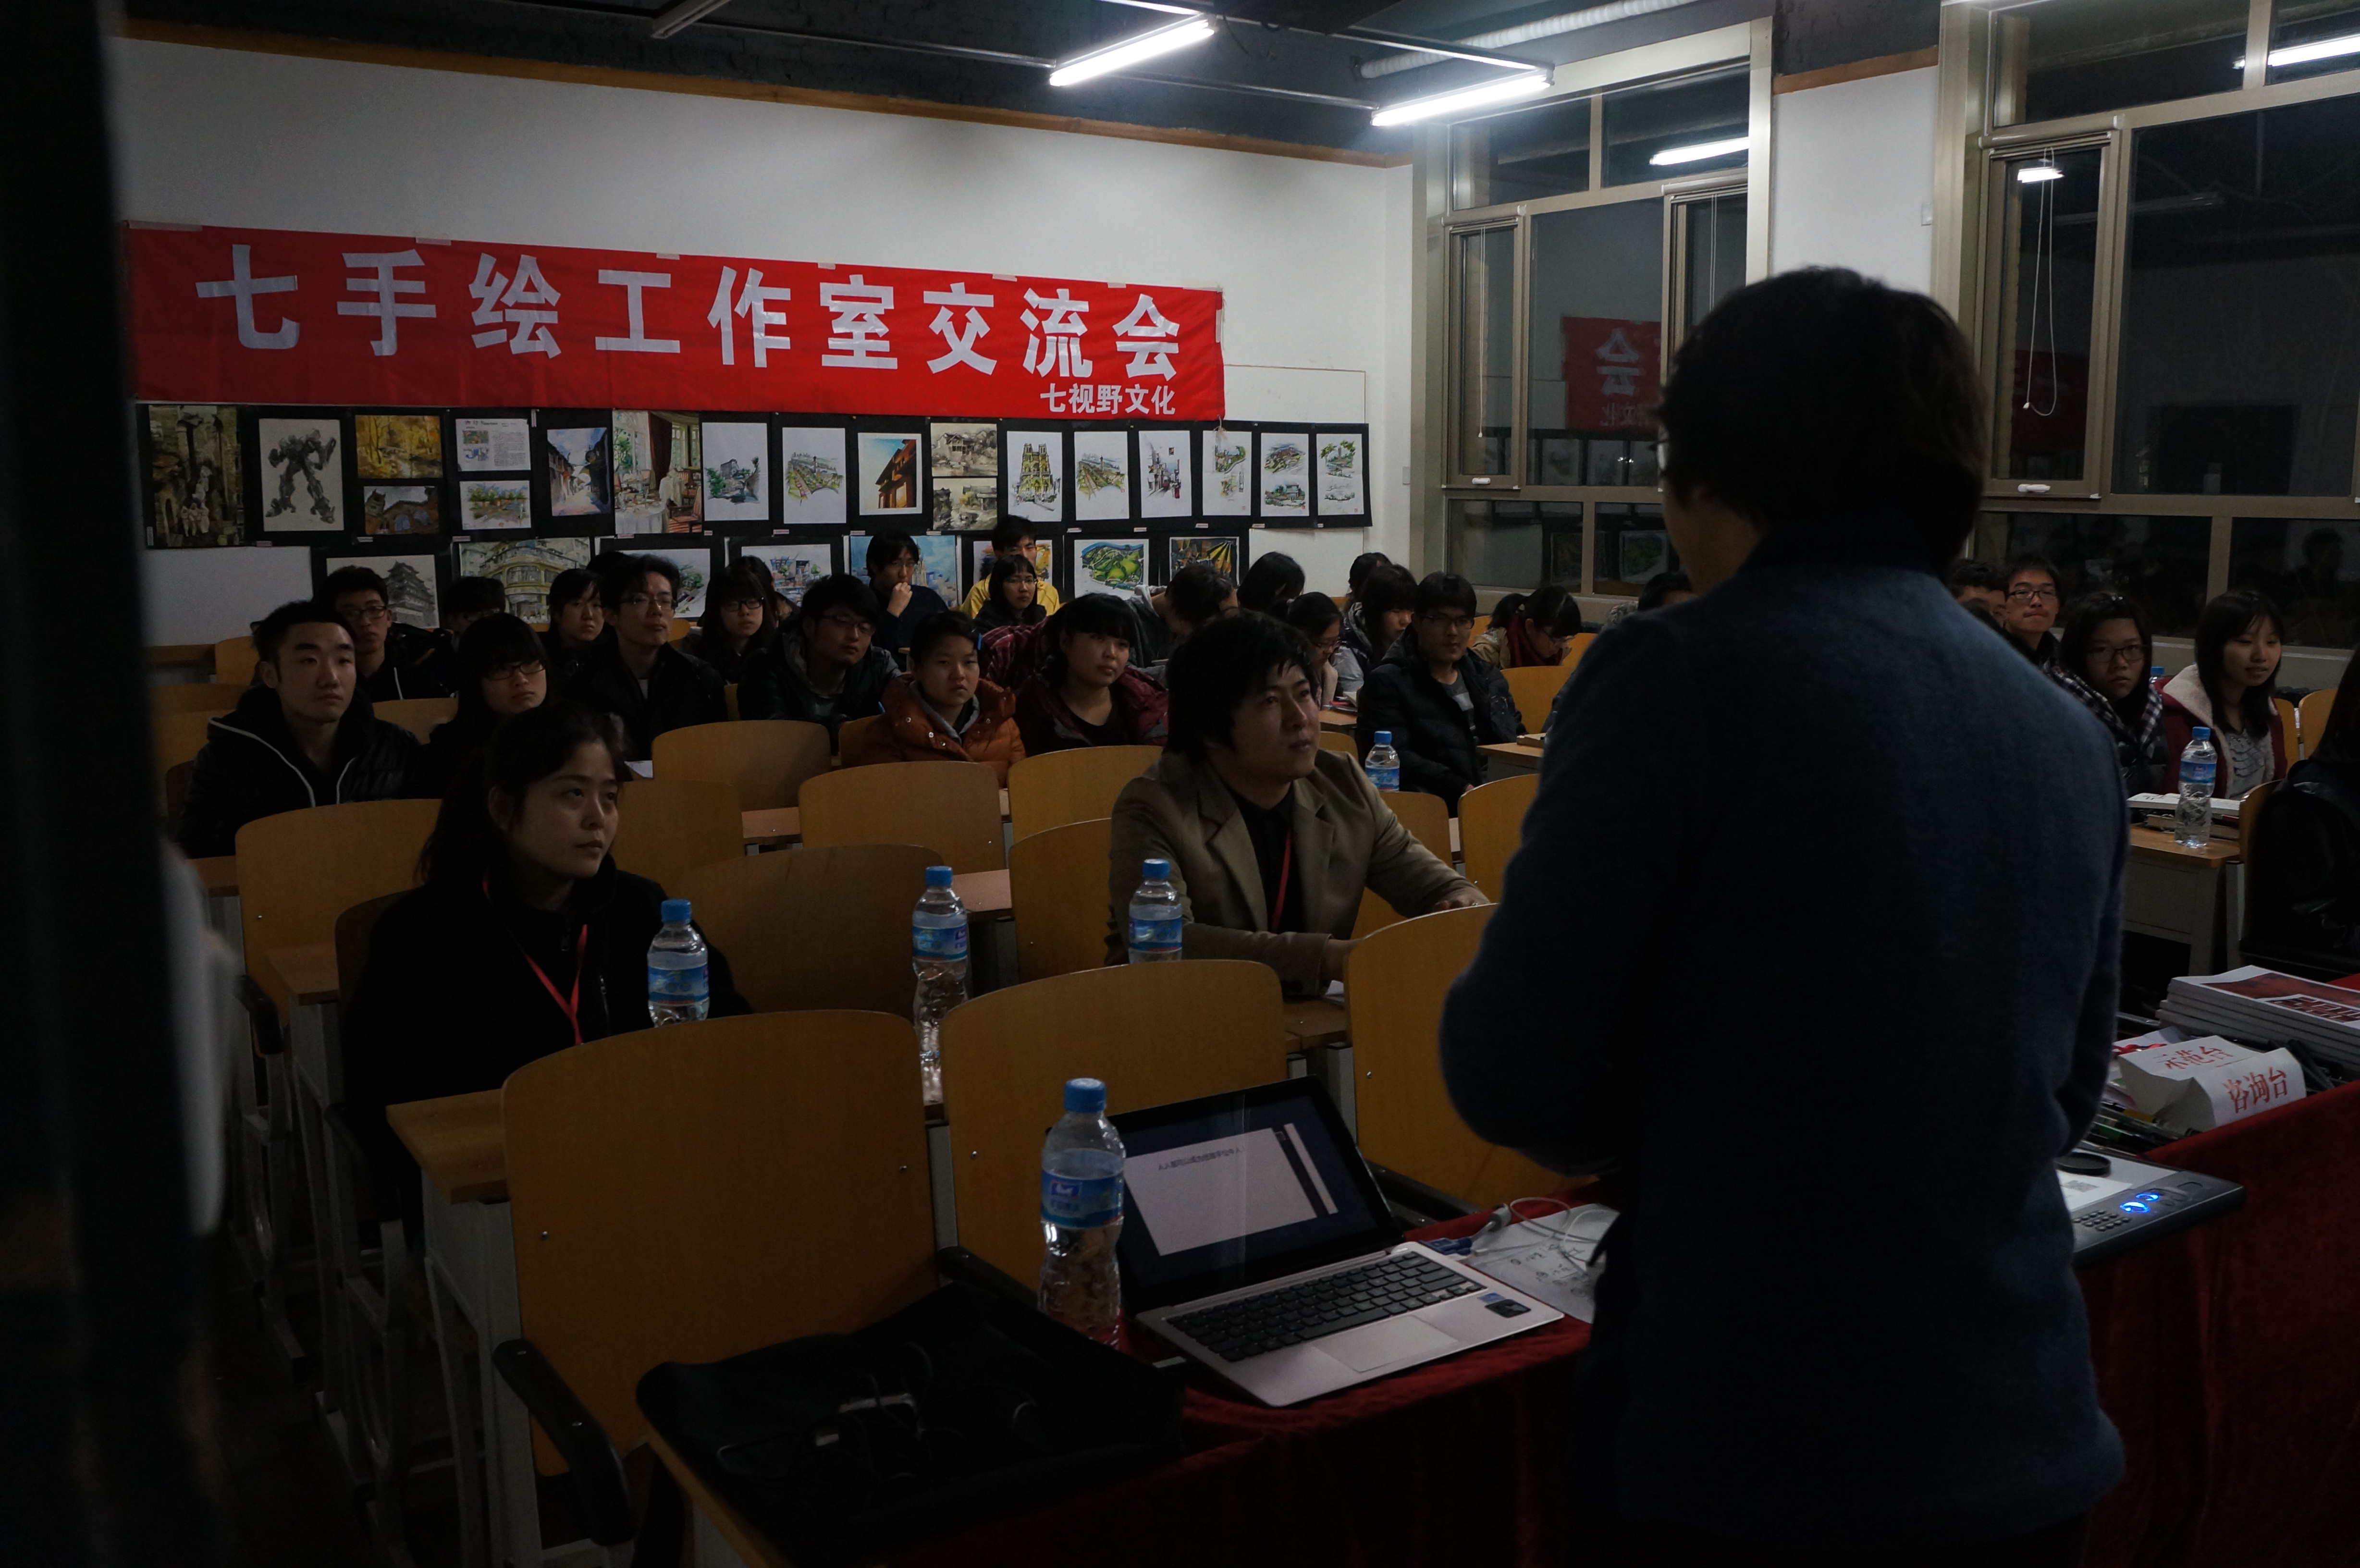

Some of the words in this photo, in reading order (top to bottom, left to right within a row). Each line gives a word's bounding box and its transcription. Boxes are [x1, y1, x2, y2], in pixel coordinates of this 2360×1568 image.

[195, 244, 1180, 381] 七手绘工作室交流会
[1040, 382, 1176, 415] 七视野文化
[2152, 1046, 2234, 1069] 示范台
[2223, 1066, 2287, 1114] 咨询台
